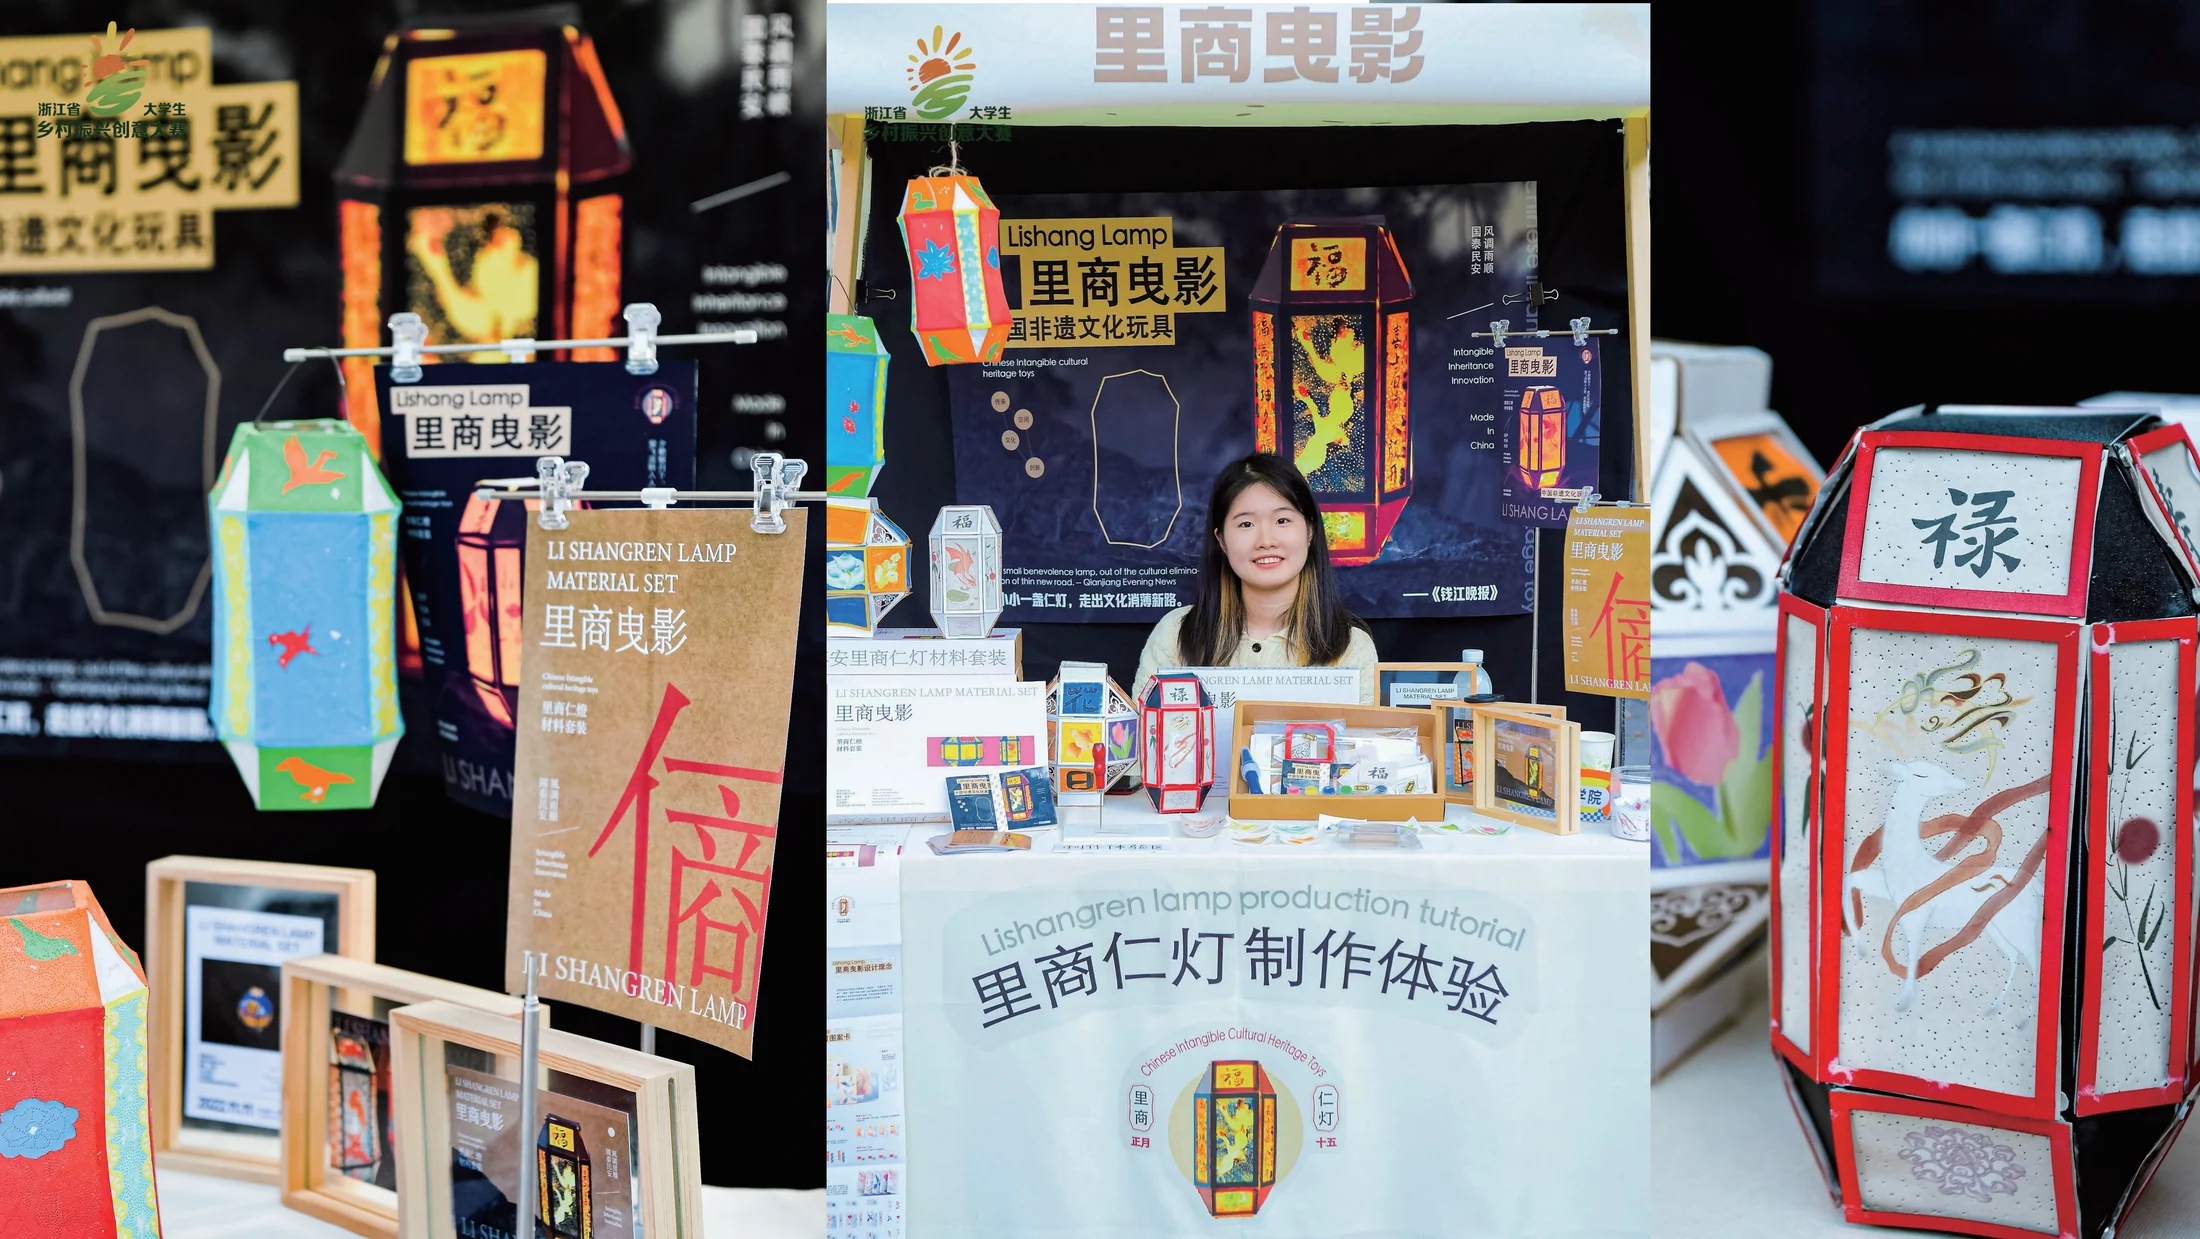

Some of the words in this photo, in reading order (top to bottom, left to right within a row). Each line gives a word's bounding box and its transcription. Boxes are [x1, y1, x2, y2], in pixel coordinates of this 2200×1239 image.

[1094, 6, 1425, 84] 里商曳影
[0, 210, 206, 256] 遗文化玩具
[1008, 225, 1095, 251] Lishang
[1102, 224, 1168, 249] Lamp
[1471, 226, 1481, 274] 国泰民安
[1484, 226, 1494, 273] 风调雨顺
[1307, 242, 1349, 288] 福
[1030, 255, 1219, 308] 里商曳影
[1008, 314, 1174, 342] 国非遗文化玩具
[1454, 348, 1494, 357] Intangible
[1507, 349, 1524, 357] Lishang
[1016, 358, 1057, 368] Intangible
[1058, 357, 1088, 366] cultural
[1448, 362, 1494, 371] Inheritance
[1510, 359, 1554, 374] 里商曳影
[982, 370, 1017, 379] heritage
[1018, 369, 1035, 378] toys
[1451, 376, 1494, 385] Innovation
[397, 391, 465, 410] Lishang
[470, 389, 523, 407] Lamp
[1470, 413, 1494, 421] Made
[414, 413, 563, 451] 里商曳影
[1470, 441, 1494, 449] China
[1502, 504, 1507, 516] LI
[1509, 504, 1548, 519] SHANG
[952, 515, 973, 529] 福
[1583, 518, 1623, 526] SHANGREN
[1623, 519, 1644, 527] LAMP
[1574, 529, 1608, 537] MATERIAL
[1609, 530, 1623, 538] SET
[1911, 488, 2022, 579] 禄
[547, 541, 564, 560] LI
[569, 541, 672, 562] SHANGREN
[678, 543, 737, 563] LAMP
[1570, 541, 1623, 561] 里商曳影
[1023, 567, 1074, 576] benevolence
[1075, 568, 1098, 577] lamp,
[1100, 568, 1112, 576] out
[1114, 567, 1123, 575] of
[1124, 567, 1137, 575] the
[1138, 567, 1168, 575] cultural
[547, 571, 639, 592] MATERIAL
[643, 574, 679, 593] SET
[1011, 577, 1020, 585] of
[1083, 578, 1121, 587] Qianjiang
[1123, 578, 1153, 587] Evening
[540, 603, 687, 656] 里商曳影
[827, 649, 1006, 667] 安里商仁灯材料套装
[1242, 676, 1272, 685] LAMP
[1275, 675, 1331, 685] MATERIAL
[1333, 676, 1353, 685] SET
[1570, 675, 1579, 684] LI
[1581, 676, 1633, 690] SHANGREN
[1636, 681, 1650, 692] LA
[836, 689, 846, 698] LI
[850, 688, 917, 698] SHANGREN
[919, 688, 952, 697] LAMP
[955, 687, 1015, 697] MATERIAL
[1018, 687, 1038, 696] SET
[1063, 686, 1099, 712] 花
[1170, 687, 1189, 702] 禄
[835, 704, 913, 722] 里商曳影
[1368, 767, 1389, 780] 福
[980, 893, 1146, 957] Lishangren
[1152, 886, 1233, 915] lamp
[1239, 885, 1410, 921] production
[1419, 899, 1527, 953] tutorial
[972, 926, 1510, 1028] 里商仁灯制作体验
[555, 956, 684, 1010] SHANGREN
[690, 989, 748, 1030] LAMP
[1141, 1047, 1176, 1077] Chinese
[1176, 1030, 1225, 1053] Intangible
[1228, 1027, 1266, 1042] Cultural
[1268, 1034, 1308, 1062] Heritage
[1306, 1055, 1326, 1077] Toys
[1222, 1067, 1245, 1086] 福
[456, 1103, 504, 1131] 里商曳影
[1134, 1091, 1148, 1125] 里商
[1318, 1091, 1334, 1126] 仁灯
[1131, 1137, 1150, 1148] 正月
[1316, 1137, 1337, 1148] 十五
